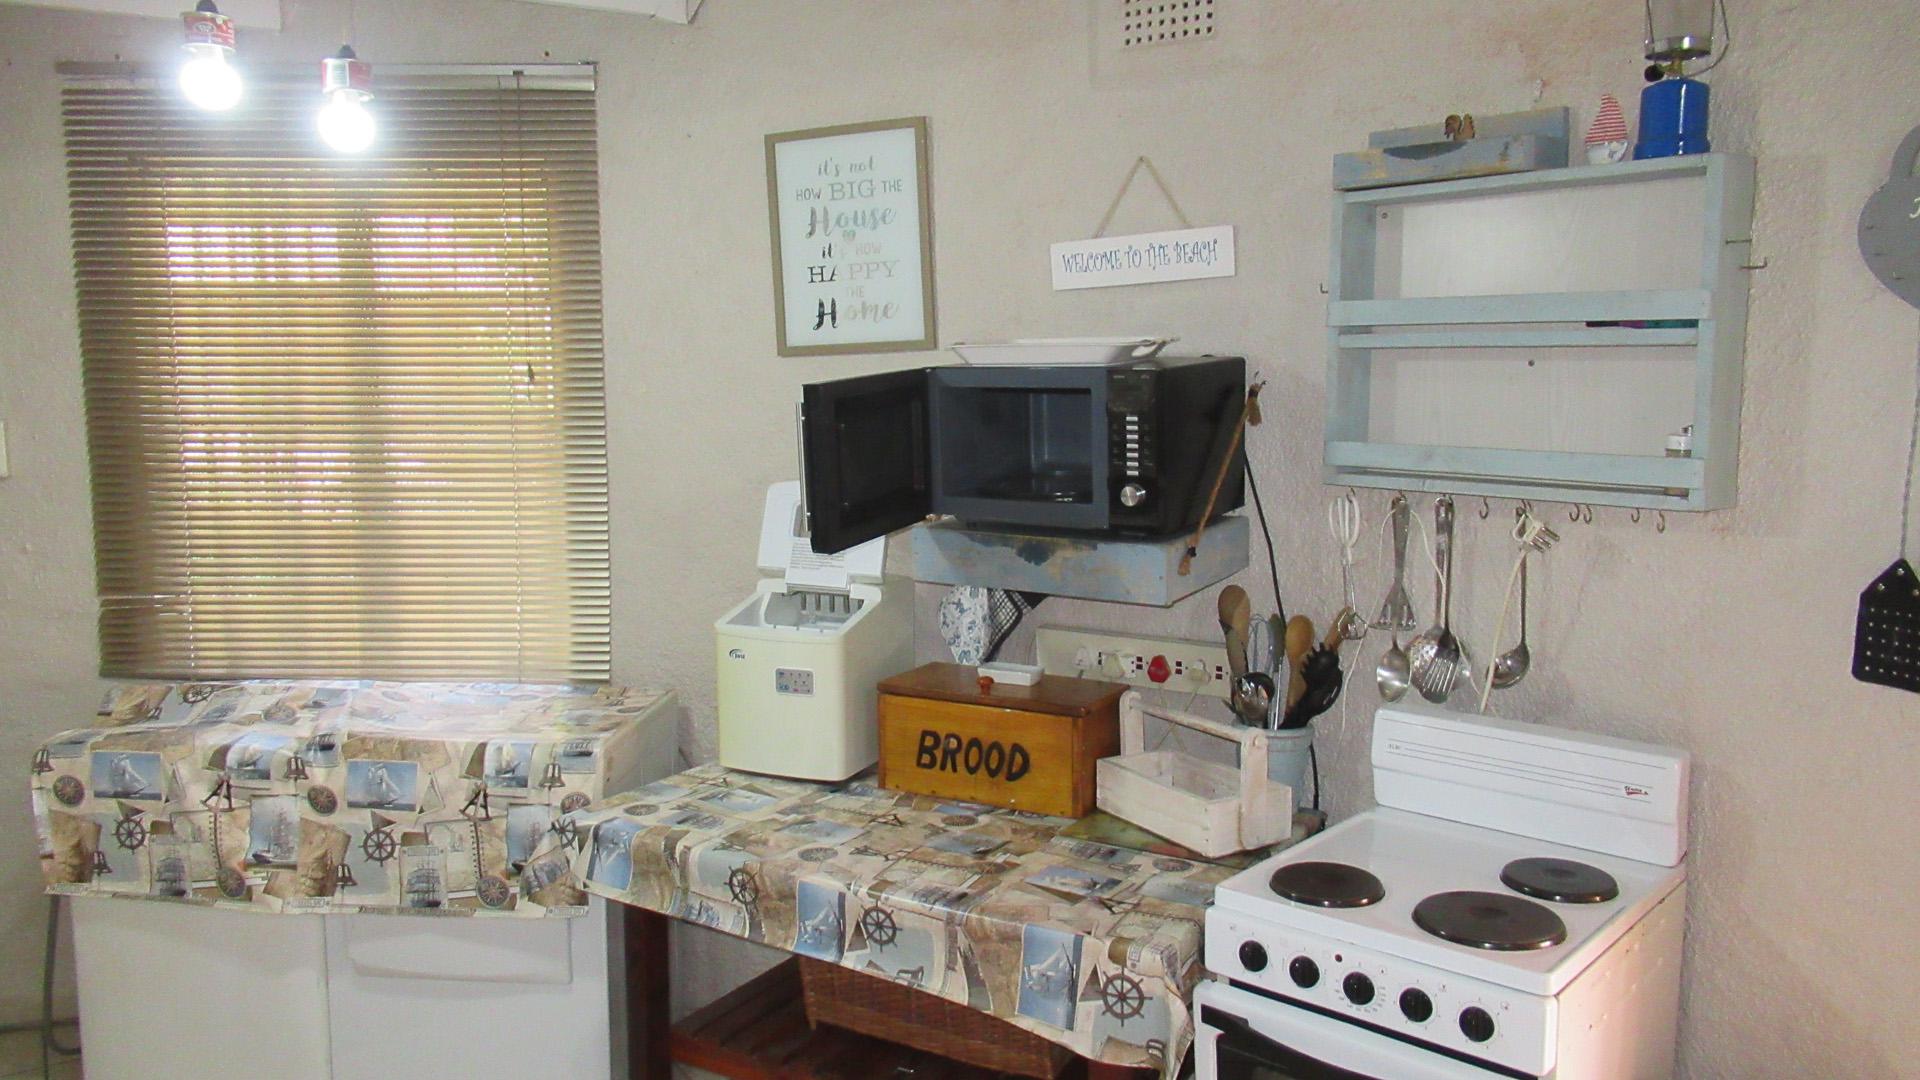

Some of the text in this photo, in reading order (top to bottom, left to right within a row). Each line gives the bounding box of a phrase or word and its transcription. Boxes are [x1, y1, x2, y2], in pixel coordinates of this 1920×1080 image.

[849, 154, 876, 174] not
[795, 178, 904, 202] HOW BIG THE
[805, 205, 897, 239] House
[807, 259, 902, 284] HAPPY
[1061, 238, 1218, 274] WELCOME TO THE BEACH
[812, 296, 901, 331] Home
[916, 730, 1031, 782] BROOD
